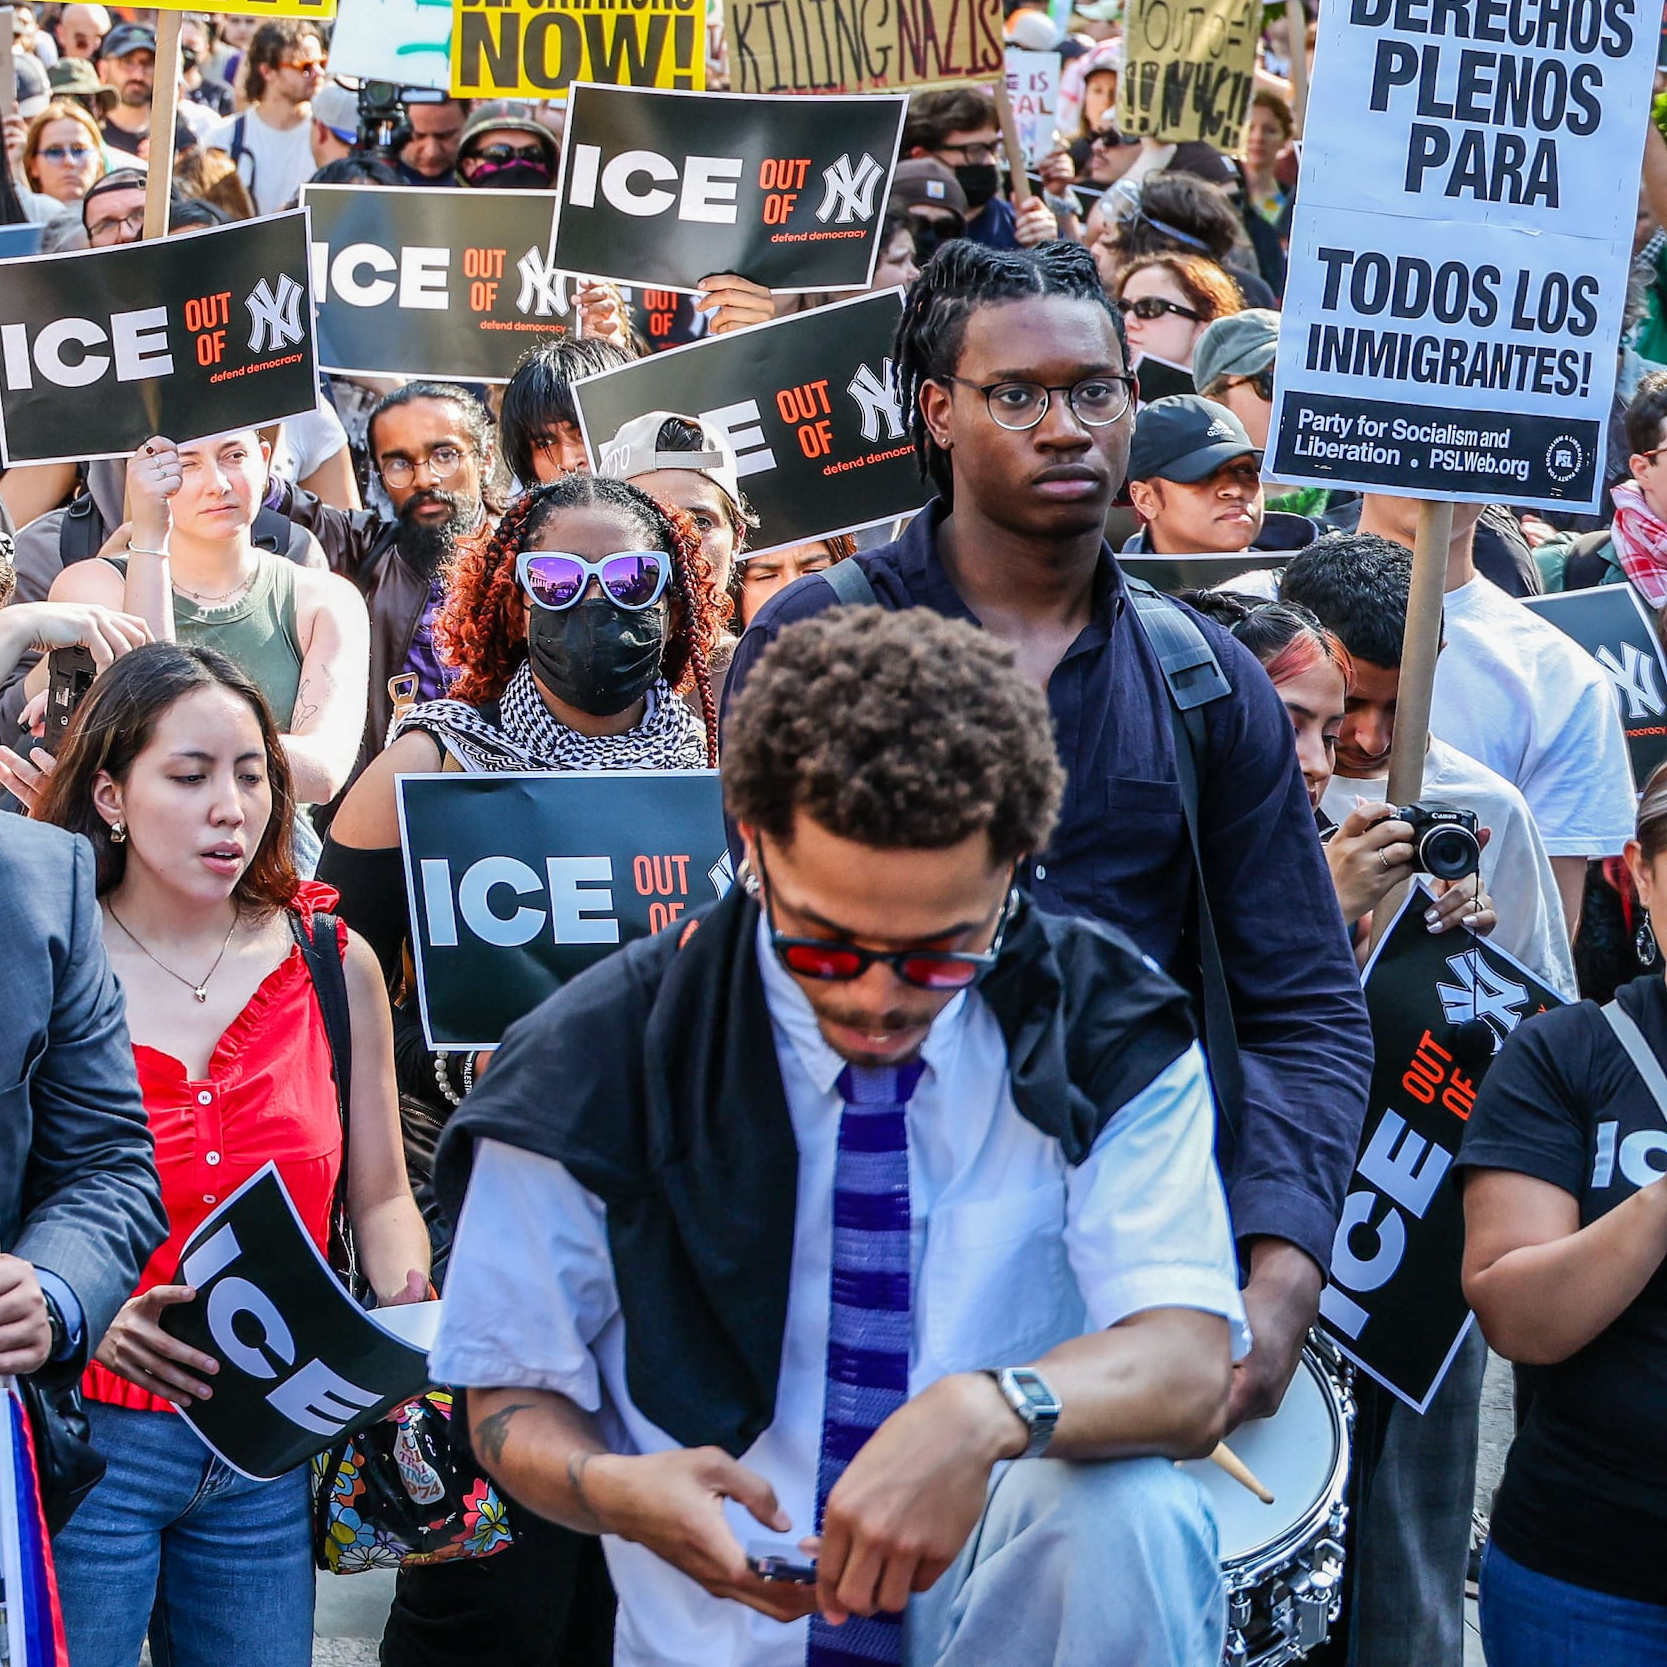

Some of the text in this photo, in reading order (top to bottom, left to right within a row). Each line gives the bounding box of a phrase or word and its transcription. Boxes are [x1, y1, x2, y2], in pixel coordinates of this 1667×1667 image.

[460, 11, 696, 90] NOW!
[1144, 0, 1205, 52] OUT
[1369, 39, 1604, 136] PLENOS
[569, 143, 744, 225] ICE
[759, 158, 812, 191] OUT
[1404, 122, 1561, 209] PARA
[763, 193, 795, 225] OF
[770, 228, 867, 243] defend democracy
[314, 242, 507, 311] ICE OUT
[470, 281, 500, 312] OF
[1318, 247, 1601, 337] TODOS LOS
[2, 306, 174, 392] ICE
[184, 291, 233, 329] OUT
[195, 329, 227, 367] OF
[479, 319, 567, 334] defend democracy
[649, 312, 673, 336] OF
[209, 352, 304, 385] defend democracy
[1305, 324, 1592, 398] INMIGRANTES!
[776, 379, 832, 425] OUT
[797, 420, 834, 460] OF
[1298, 408, 1510, 450] Party for Socialism and
[822, 455, 865, 477] defend
[1293, 434, 1530, 481] Liberation PSLWeb.org
[1555, 449, 1573, 468] PSL
[1431, 812, 1457, 820] Canon
[420, 854, 691, 948] ICE OUT
[1401, 1028, 1453, 1106] OUT
[1440, 1067, 1478, 1122] OF
[1319, 1106, 1453, 1342] ICE
[183, 1222, 385, 1436] ICE
